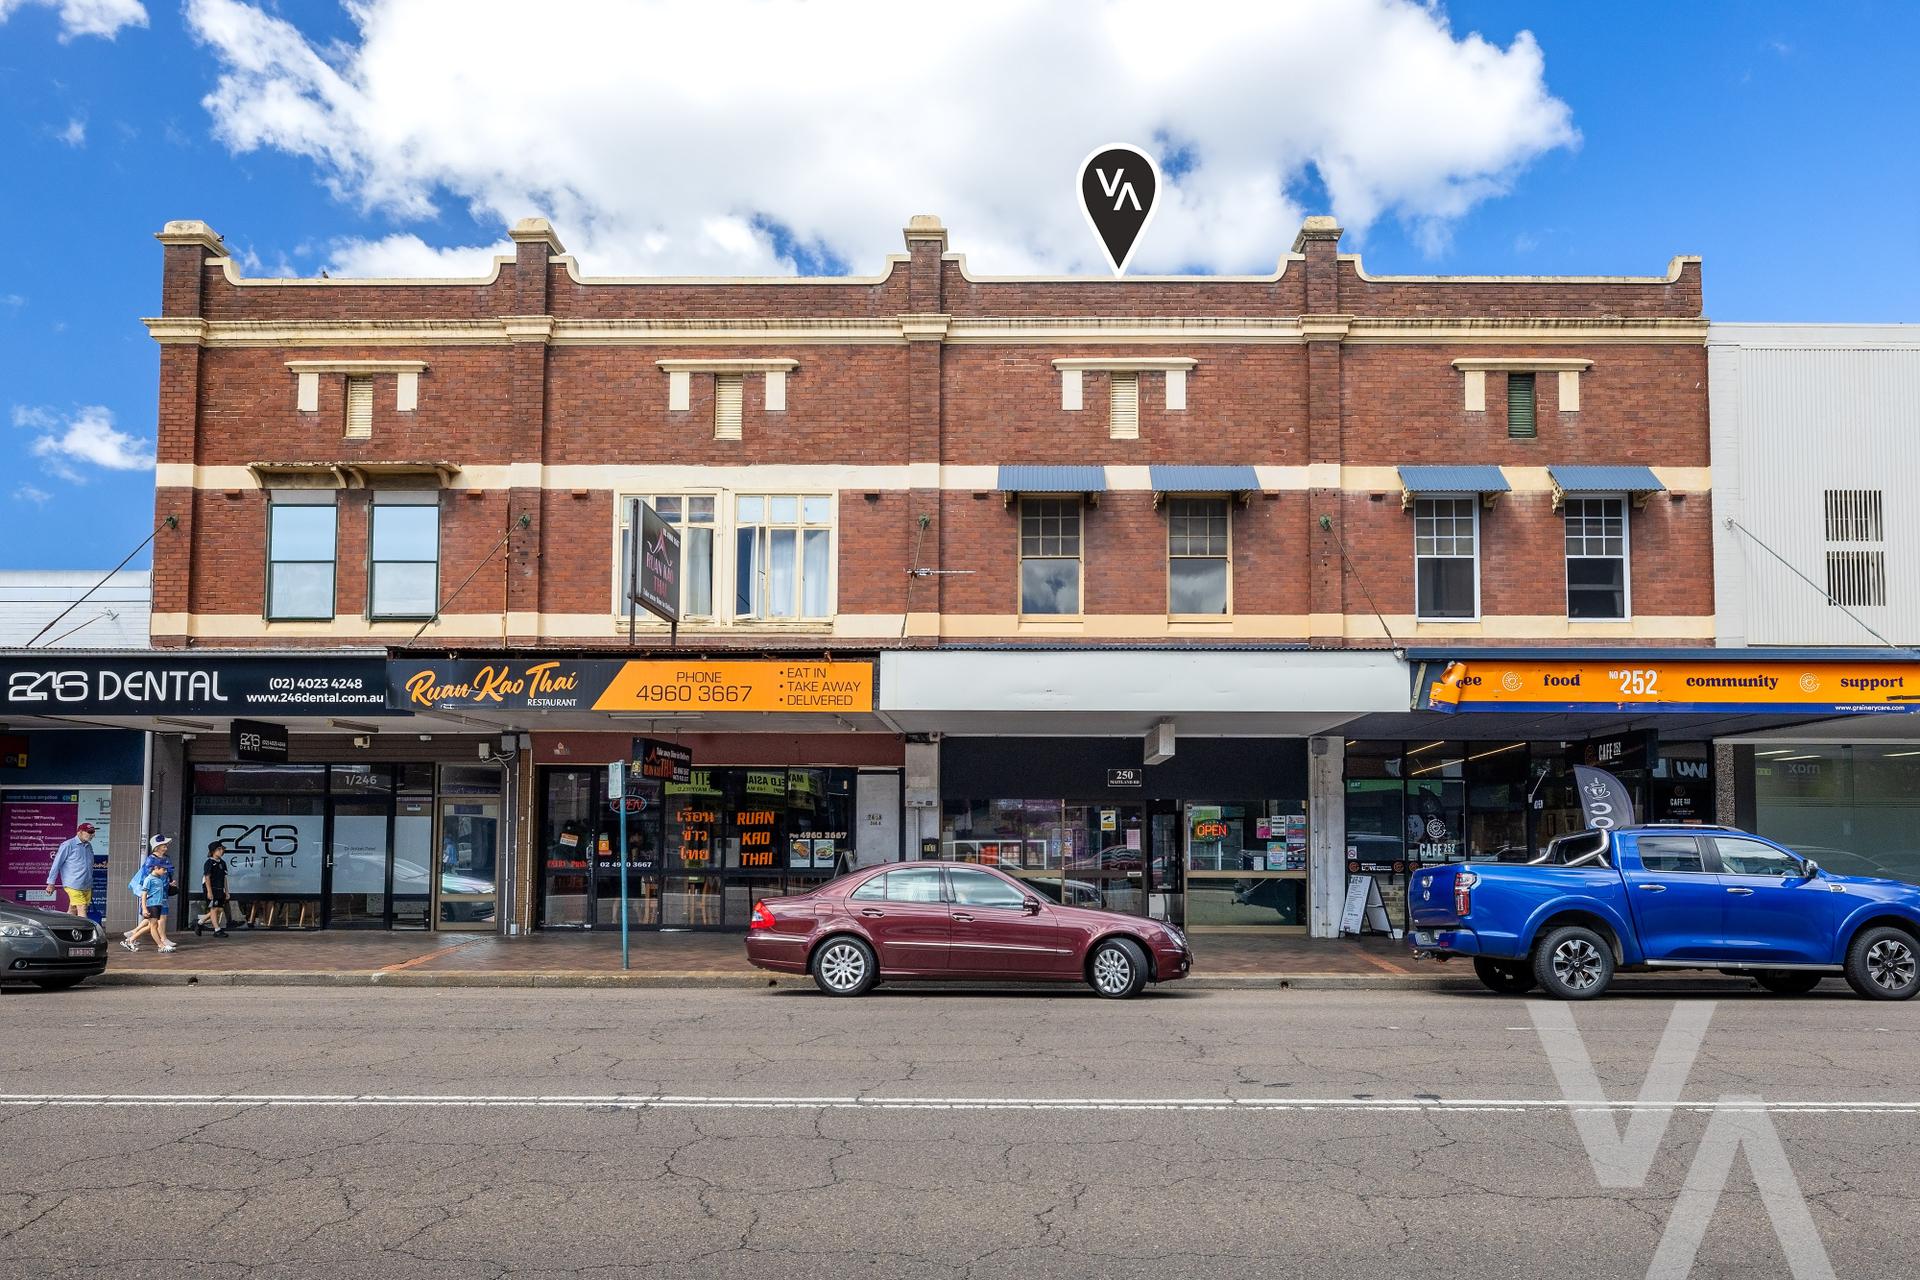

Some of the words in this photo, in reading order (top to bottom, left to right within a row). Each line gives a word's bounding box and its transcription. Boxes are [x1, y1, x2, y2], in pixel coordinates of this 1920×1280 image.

[676, 671, 722, 683] PHONE
[787, 667, 811, 679] EAT
[813, 667, 826, 679] IN
[8, 671, 88, 701] 246
[99, 671, 228, 701] DENTAL
[269, 678, 295, 690] (02)
[297, 679, 329, 689] 4023
[331, 679, 363, 689] 4248
[405, 670, 473, 707] Ruan
[472, 665, 525, 702] Kao
[525, 661, 578, 699] Thai
[787, 681, 818, 692] TAKE
[821, 681, 861, 692] AWAY
[1543, 673, 1581, 687] food
[1619, 669, 1658, 695] 252
[1686, 674, 1779, 690] community
[1840, 675, 1904, 690] support
[246, 692, 384, 703] www.246dental.com.au
[636, 685, 692, 702] 4960
[698, 685, 753, 702] 3667
[787, 694, 852, 706] DELIVERED
[527, 698, 578, 707] RESTAURANT
[1598, 743, 1613, 760] CAFE
[345, 775, 377, 786] 1/246
[1116, 770, 1133, 780] 250
[611, 798, 643, 809] OEN
[1670, 798, 1683, 806] CAFE
[737, 811, 775, 825] RUAN
[1196, 824, 1227, 837] OPEN
[216, 824, 299, 855] 246
[742, 832, 771, 846] KAO
[1419, 843, 1442, 856] CAFE
[1444, 844, 1455, 853] 252
[229, 856, 298, 869] ENTAL
[741, 851, 773, 866] THAI
